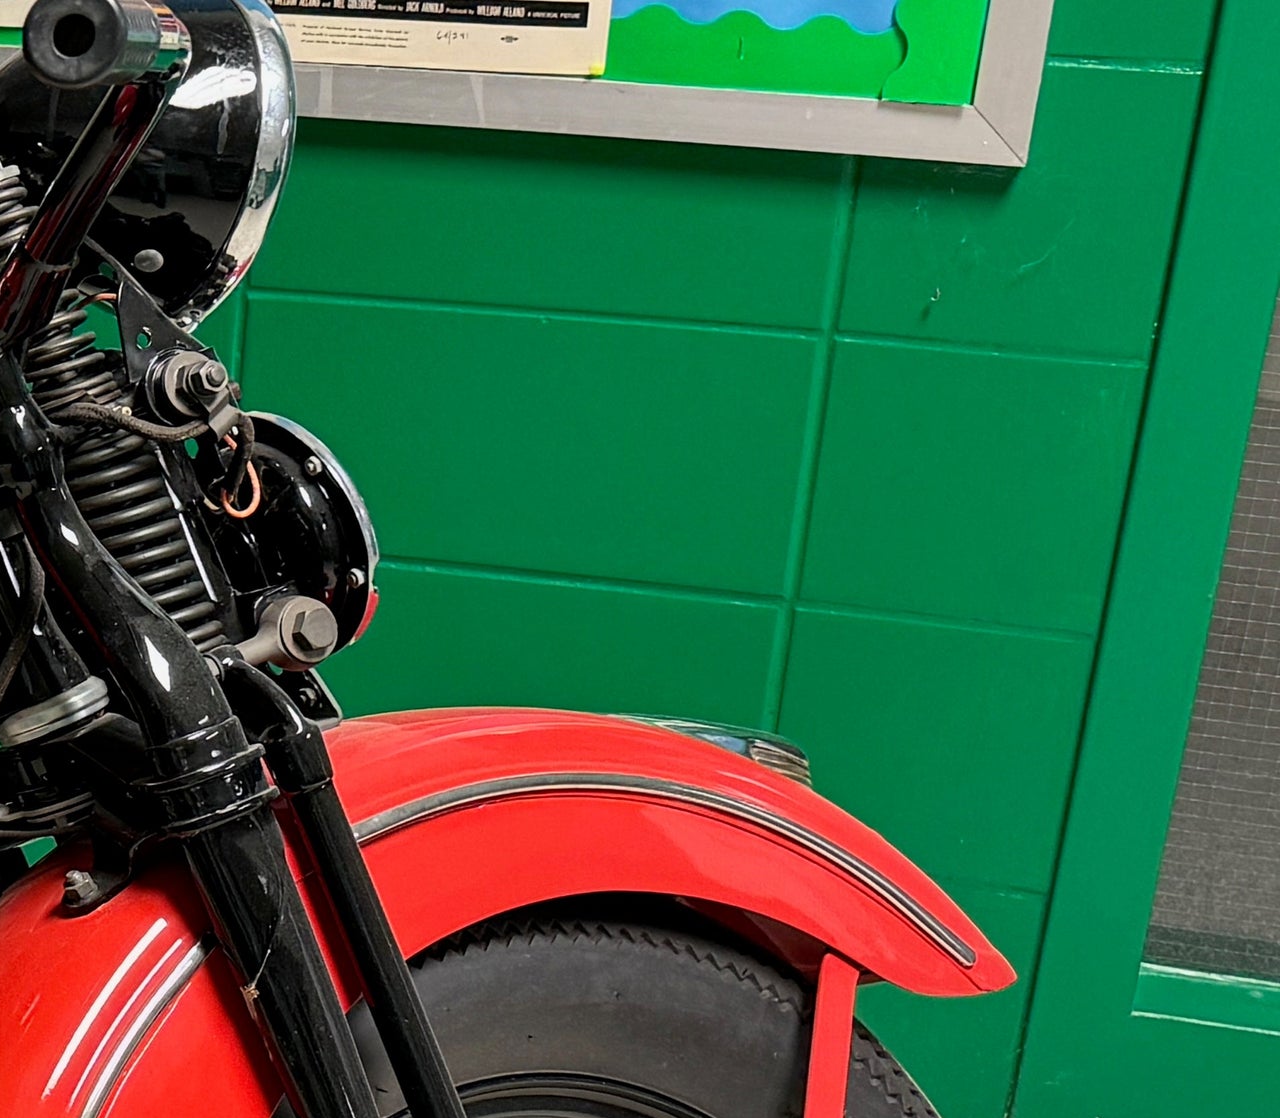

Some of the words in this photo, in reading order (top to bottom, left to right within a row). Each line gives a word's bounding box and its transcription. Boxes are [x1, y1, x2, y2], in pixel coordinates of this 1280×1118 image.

[406, 1, 420, 12] JACK
[421, 2, 444, 13] ARNOLD
[476, 5, 501, 16] WILLIAM
[502, 6, 525, 18] ALLAND
